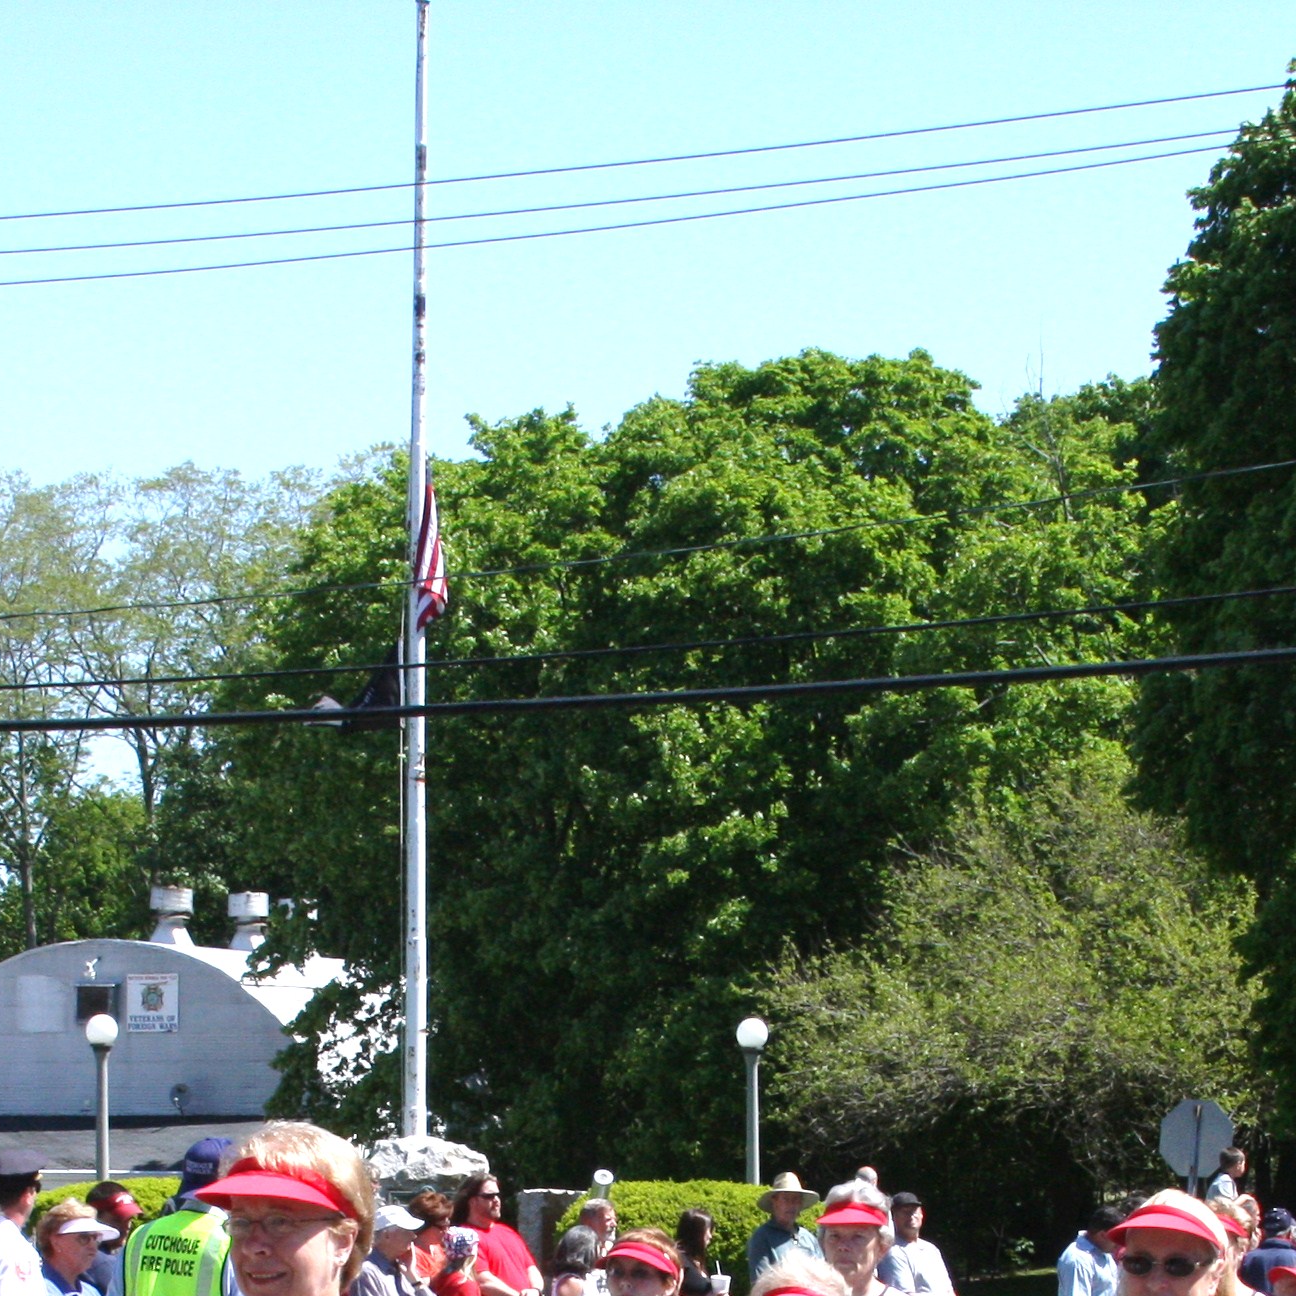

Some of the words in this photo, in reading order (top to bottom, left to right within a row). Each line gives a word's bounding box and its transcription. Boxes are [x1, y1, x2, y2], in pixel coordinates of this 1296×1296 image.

[145, 1235, 201, 1255] CUTCHOGUE
[141, 1255, 163, 1272] FIRE
[164, 1258, 196, 1277] POLICE
